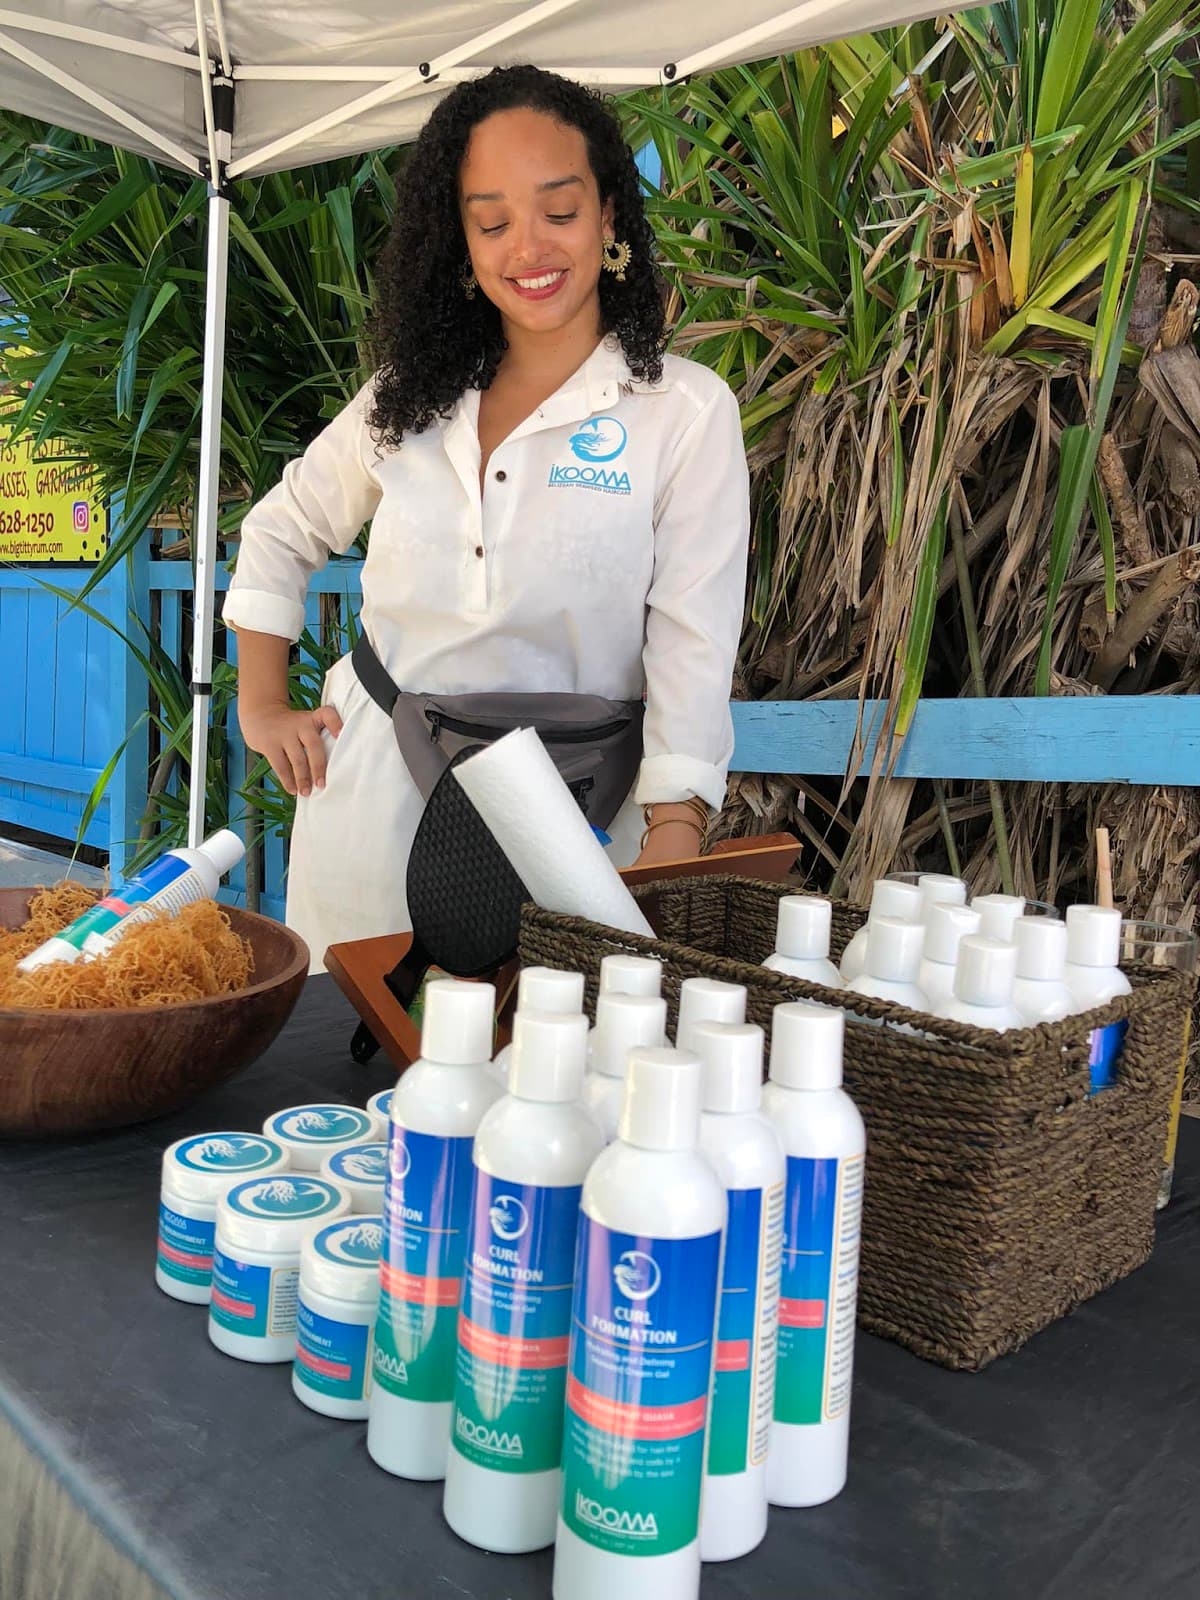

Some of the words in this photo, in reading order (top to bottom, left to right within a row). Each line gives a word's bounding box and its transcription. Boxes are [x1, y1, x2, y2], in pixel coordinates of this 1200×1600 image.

[489, 1245, 520, 1264] CURL
[472, 1252, 543, 1282] FORMATION
[614, 1306, 653, 1325] CURL
[592, 1315, 677, 1344] FORMATION
